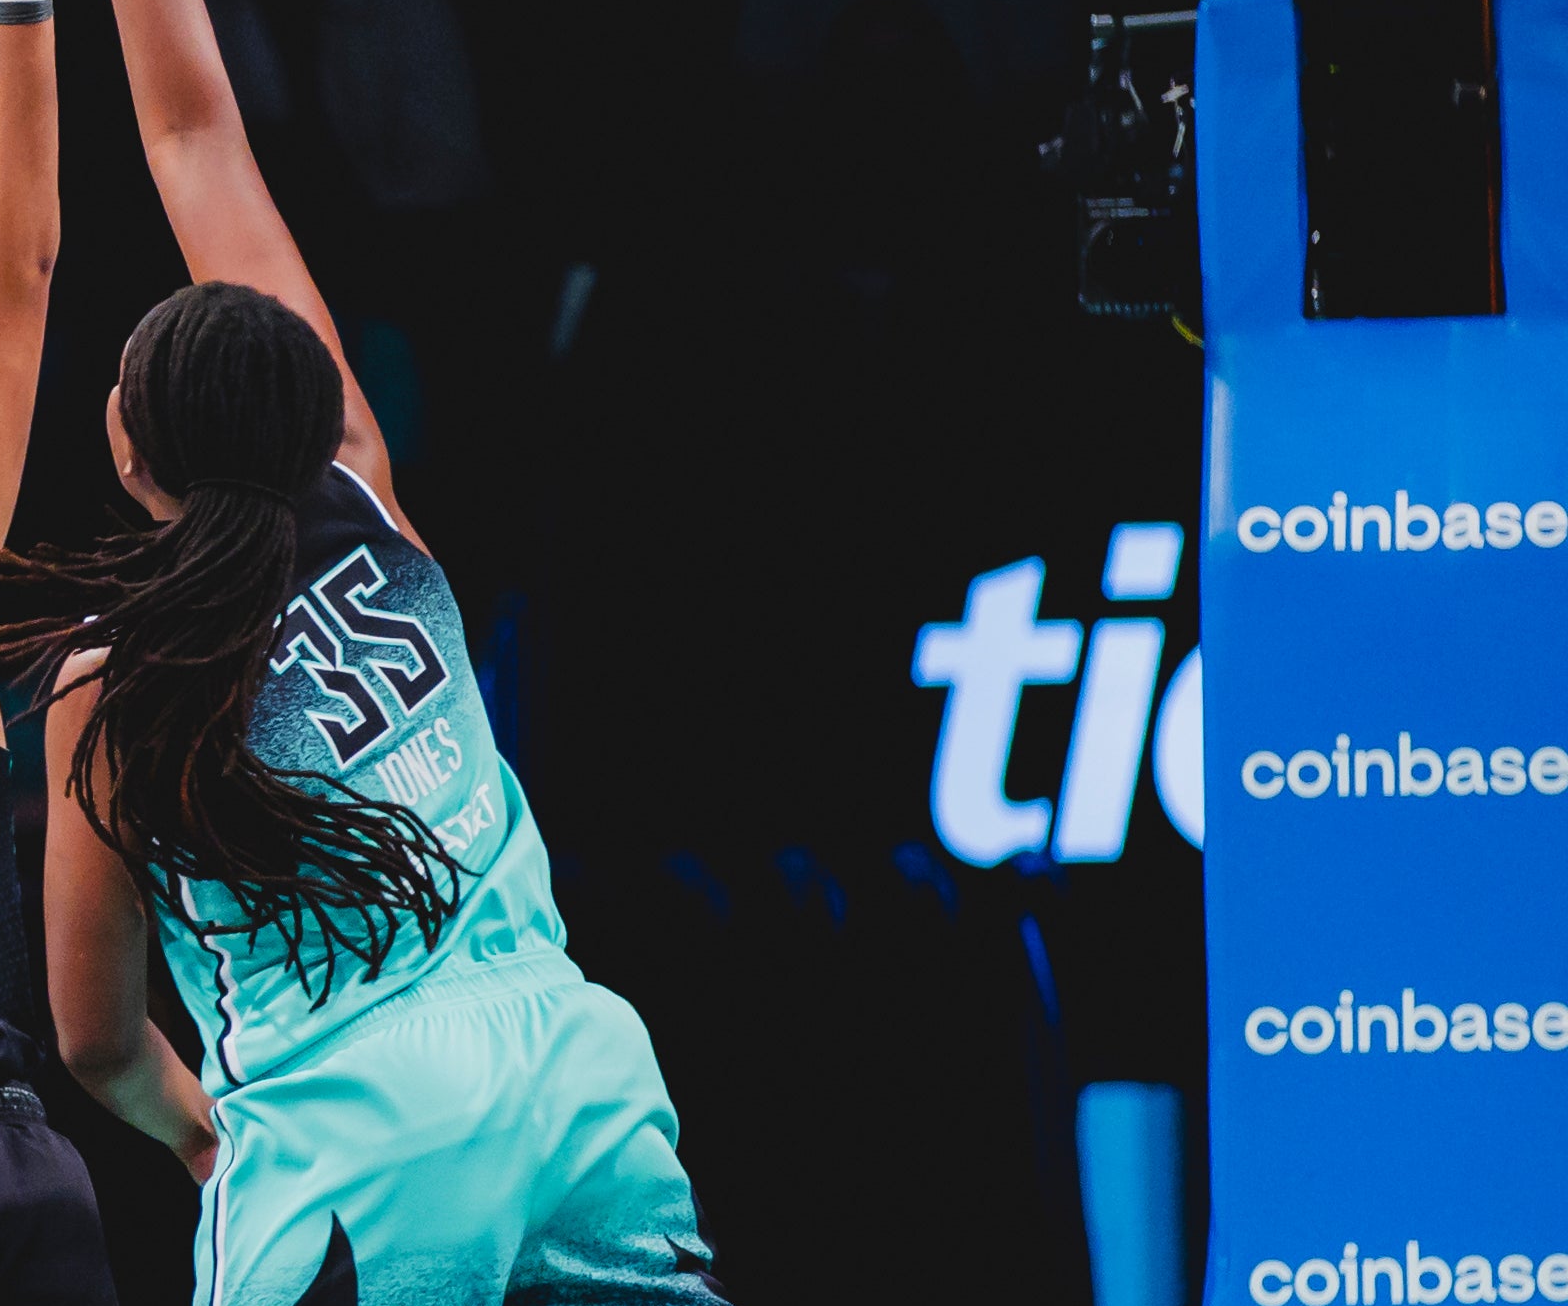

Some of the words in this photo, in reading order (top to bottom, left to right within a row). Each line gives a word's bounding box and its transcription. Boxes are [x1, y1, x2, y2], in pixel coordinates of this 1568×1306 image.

[1237, 490, 1568, 553] coinbase
[268, 544, 452, 770] 35
[1241, 731, 1568, 799] coinbase
[1244, 988, 1568, 1055] coinbase
